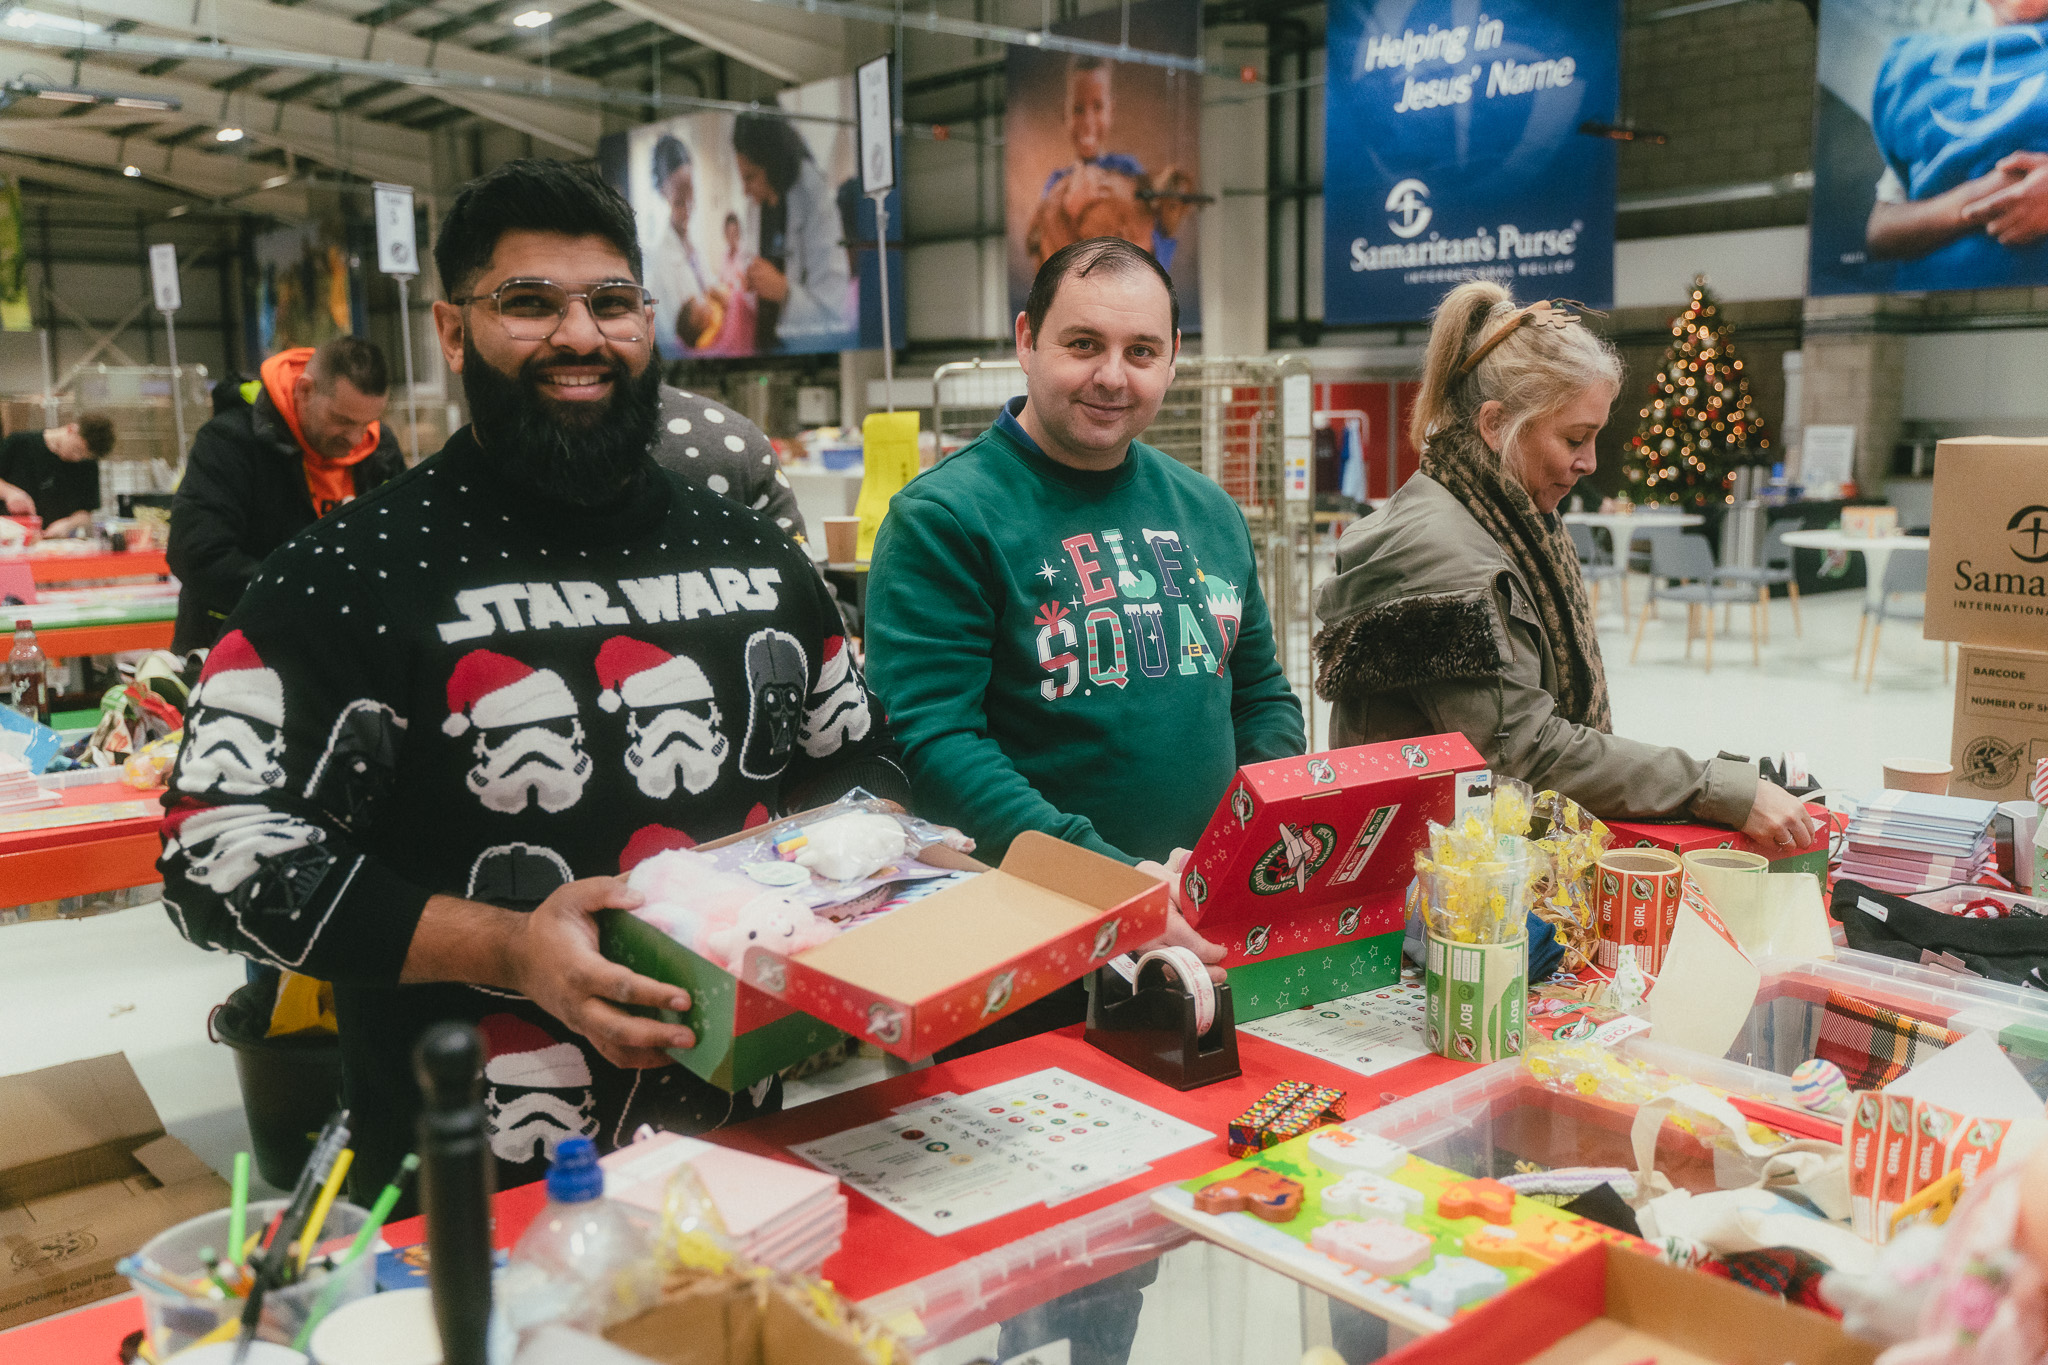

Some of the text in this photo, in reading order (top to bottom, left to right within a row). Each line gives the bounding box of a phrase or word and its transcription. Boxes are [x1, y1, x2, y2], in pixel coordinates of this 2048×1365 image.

[1364, 13, 1504, 72] Helping in
[1393, 56, 1576, 113] Jesus' Name
[1350, 226, 1496, 272] Samaritan's
[1060, 528, 1183, 606] ELF
[436, 567, 782, 645] STAR WARS
[1034, 601, 1242, 702] SQUAD
[1973, 667, 2026, 680] BARCODE
[1970, 696, 2016, 710] NUMBER
[2018, 701, 2034, 711] OF
[1255, 844, 1284, 872] Purse
[1602, 898, 1612, 922] GIRL
[1633, 903, 1646, 927] GIRL
[1665, 901, 1675, 926] GIRL
[1705, 910, 1725, 933] GIRL
[1430, 994, 1439, 1021] BOY
[1460, 1003, 1473, 1030] BOY
[1510, 999, 1519, 1024] BOY
[1603, 1025, 1640, 1043] BOX
[1854, 1133, 1870, 1169] GIRL
[1887, 1137, 1903, 1175] GIRL
[1918, 1142, 1935, 1180] GIRL
